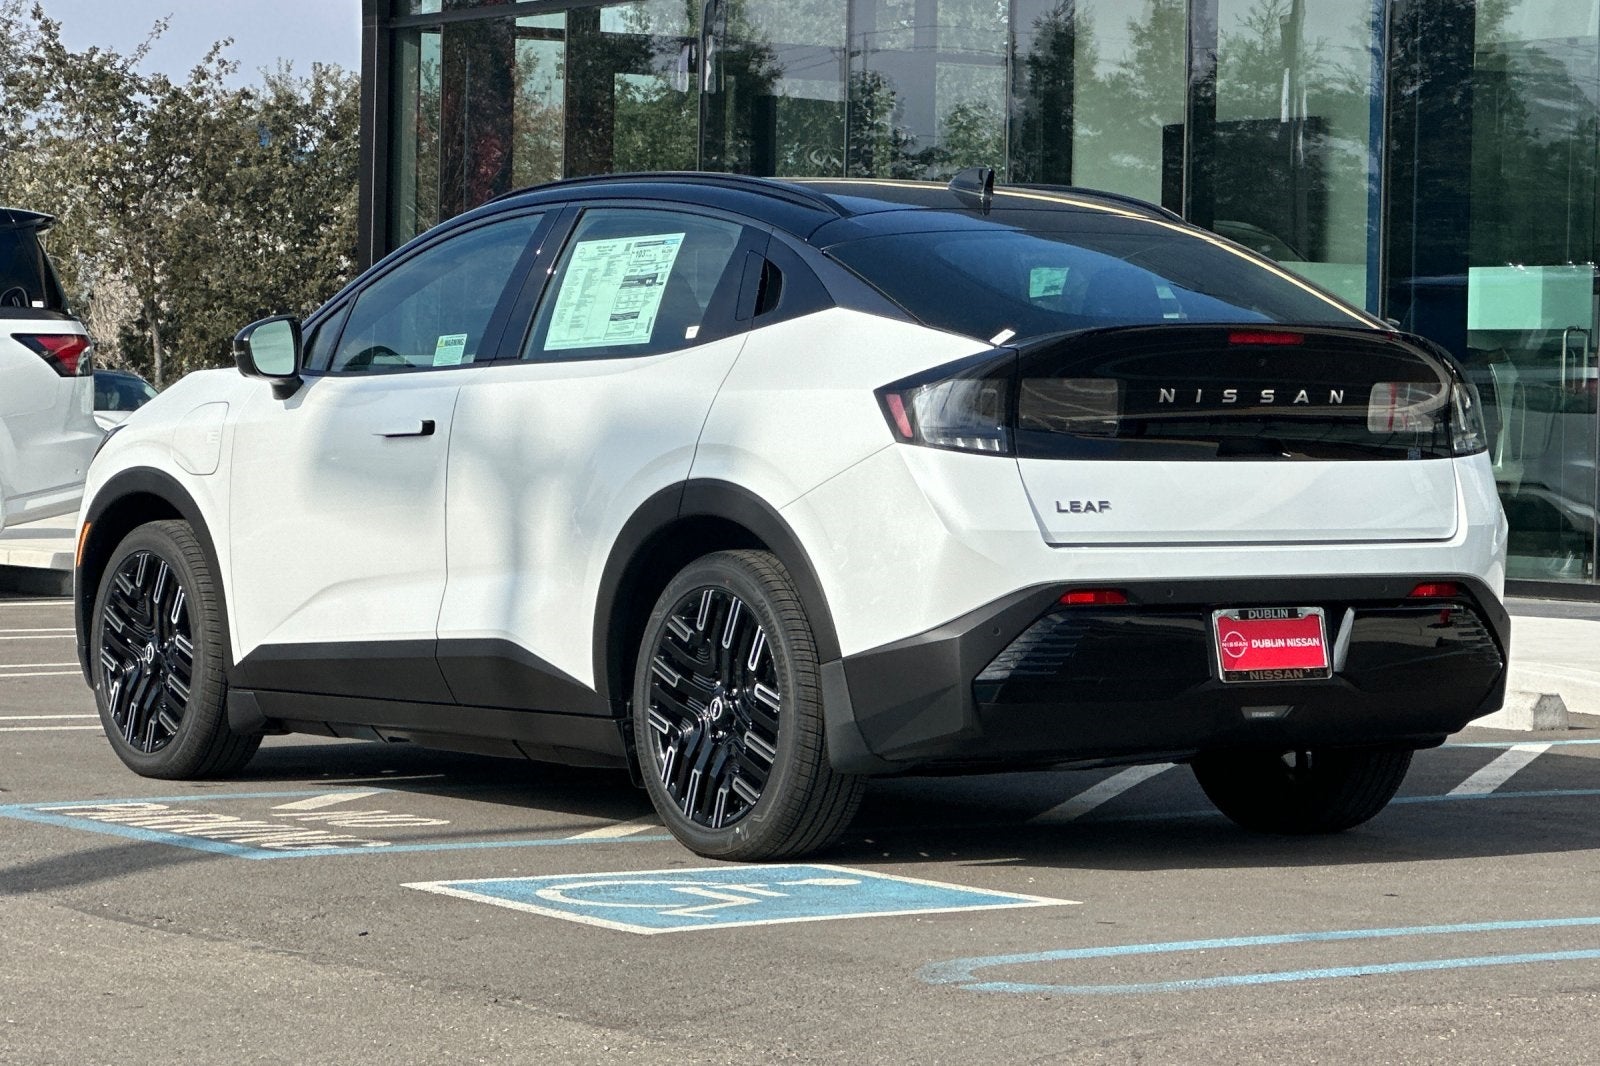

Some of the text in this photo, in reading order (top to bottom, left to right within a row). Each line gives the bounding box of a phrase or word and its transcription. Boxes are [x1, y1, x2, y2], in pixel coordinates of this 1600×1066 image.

[1159, 388, 1344, 404] NISSAN
[1055, 500, 1112, 513] LEAF
[1248, 609, 1289, 619] DUBLIN
[1251, 638, 1320, 648] DUBLIN NISSAN
[1249, 670, 1304, 680] NISSAN
[271, 809, 450, 828] NO
[34, 802, 392, 850] PARKING
